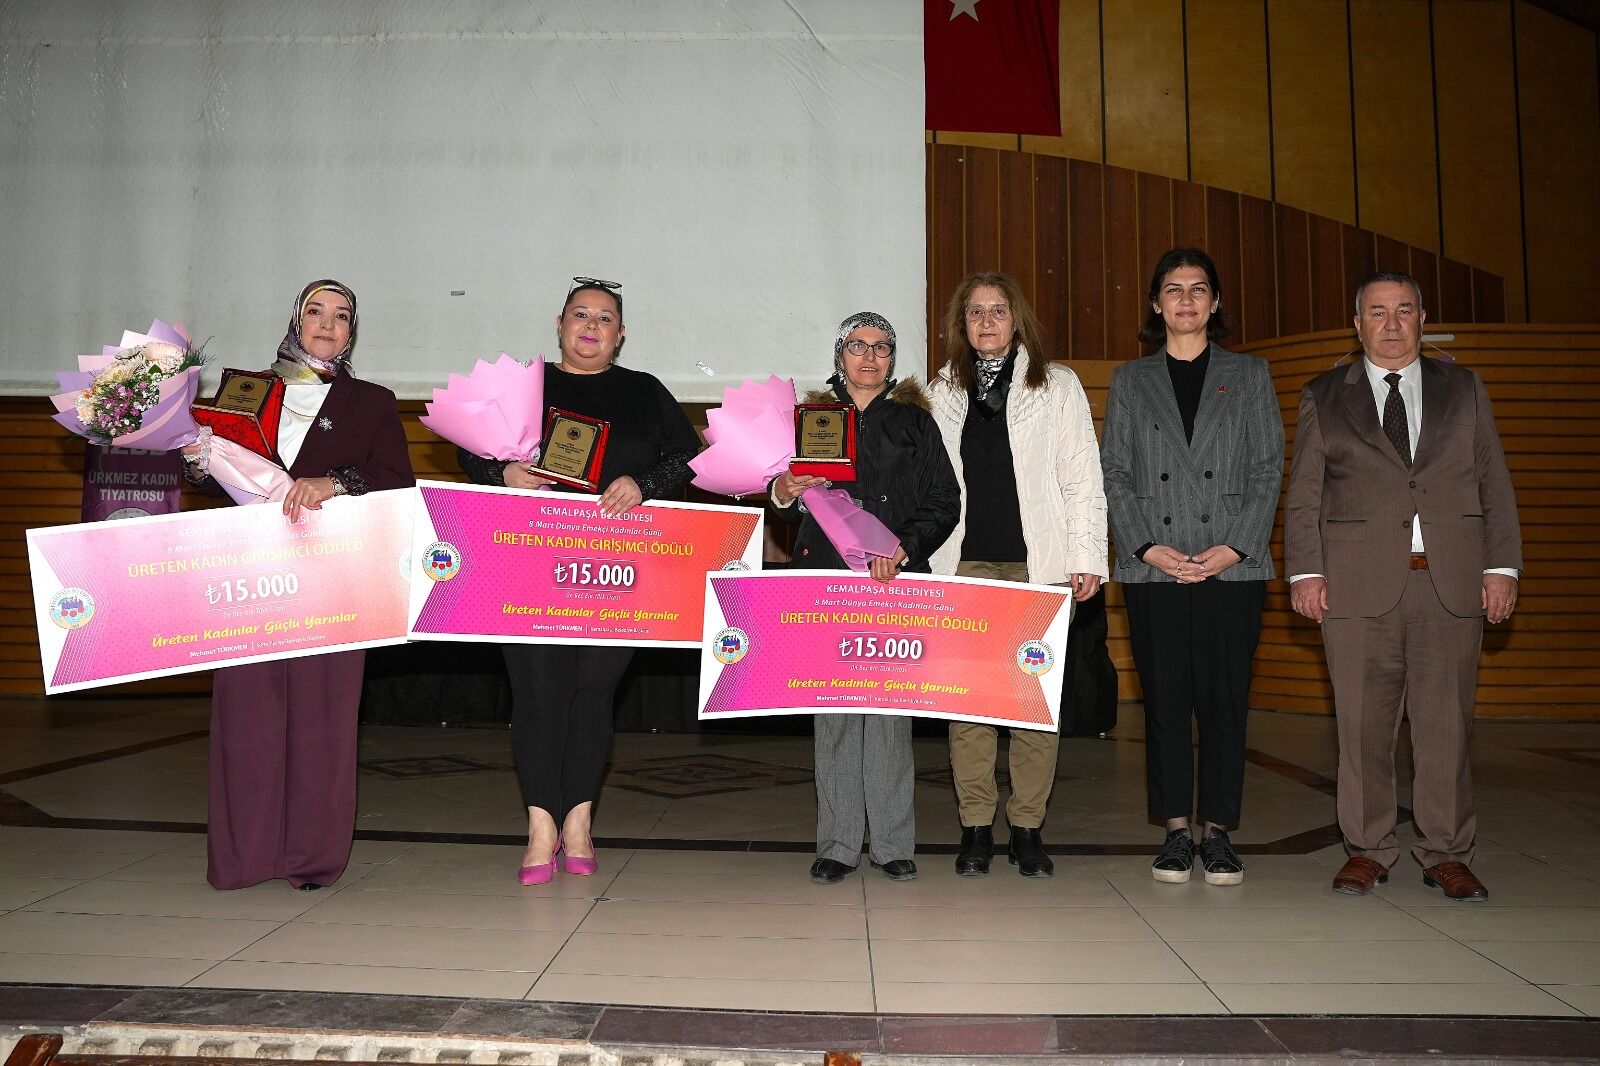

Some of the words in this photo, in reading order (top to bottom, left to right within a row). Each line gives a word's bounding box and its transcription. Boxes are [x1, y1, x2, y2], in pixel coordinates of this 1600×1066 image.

[88, 471, 138, 485] ÜRKMEZ
[141, 473, 178, 486] KADIN
[100, 486, 164, 502] TİYATROSU
[540, 506, 598, 520] KEMALPAŞA
[528, 520, 534, 528] 8
[535, 521, 554, 529] Mart
[555, 522, 580, 532] Dünya
[582, 524, 608, 534] Emekçi
[609, 526, 641, 536] Kadınlar
[643, 528, 663, 537] Günü
[493, 530, 543, 547] ÜRETEN
[547, 535, 587, 550] KADIN
[590, 537, 648, 554] GİRİŞİMCİ
[650, 541, 693, 556] ÖDÜLÜ
[128, 559, 187, 578] ÜRETEN
[191, 553, 237, 571] KADIN
[554, 562, 635, 587] ₺15.000
[204, 572, 299, 605] ₺15.000
[826, 584, 885, 595] KEMALPAŞA
[888, 586, 945, 598] BELEDİYESİ
[502, 602, 542, 616] Üreten
[546, 605, 595, 618] Kadınlar
[599, 608, 630, 621] Güçlü
[633, 609, 680, 622] Yarınlar
[814, 598, 820, 606] 8
[841, 599, 867, 608] Dünya
[868, 599, 896, 609] Emekçi
[897, 601, 931, 610] Kadınlar
[933, 603, 955, 612] Günü
[152, 633, 198, 648] Üreten
[203, 625, 259, 641] Kadınlar
[265, 617, 300, 634] Güçlü
[304, 612, 358, 629] Yarınlar
[780, 610, 829, 624] ÜRETEN
[832, 612, 873, 625] KADIN
[876, 612, 938, 629] GİRİŞİMCİ
[941, 616, 989, 633] ÖDÜLÜ
[838, 636, 923, 660] ₺15.000
[787, 676, 826, 688] Üreten
[830, 678, 880, 689] Kadınlar
[884, 679, 917, 692] Güçlü
[920, 681, 970, 695] Yarınlar
